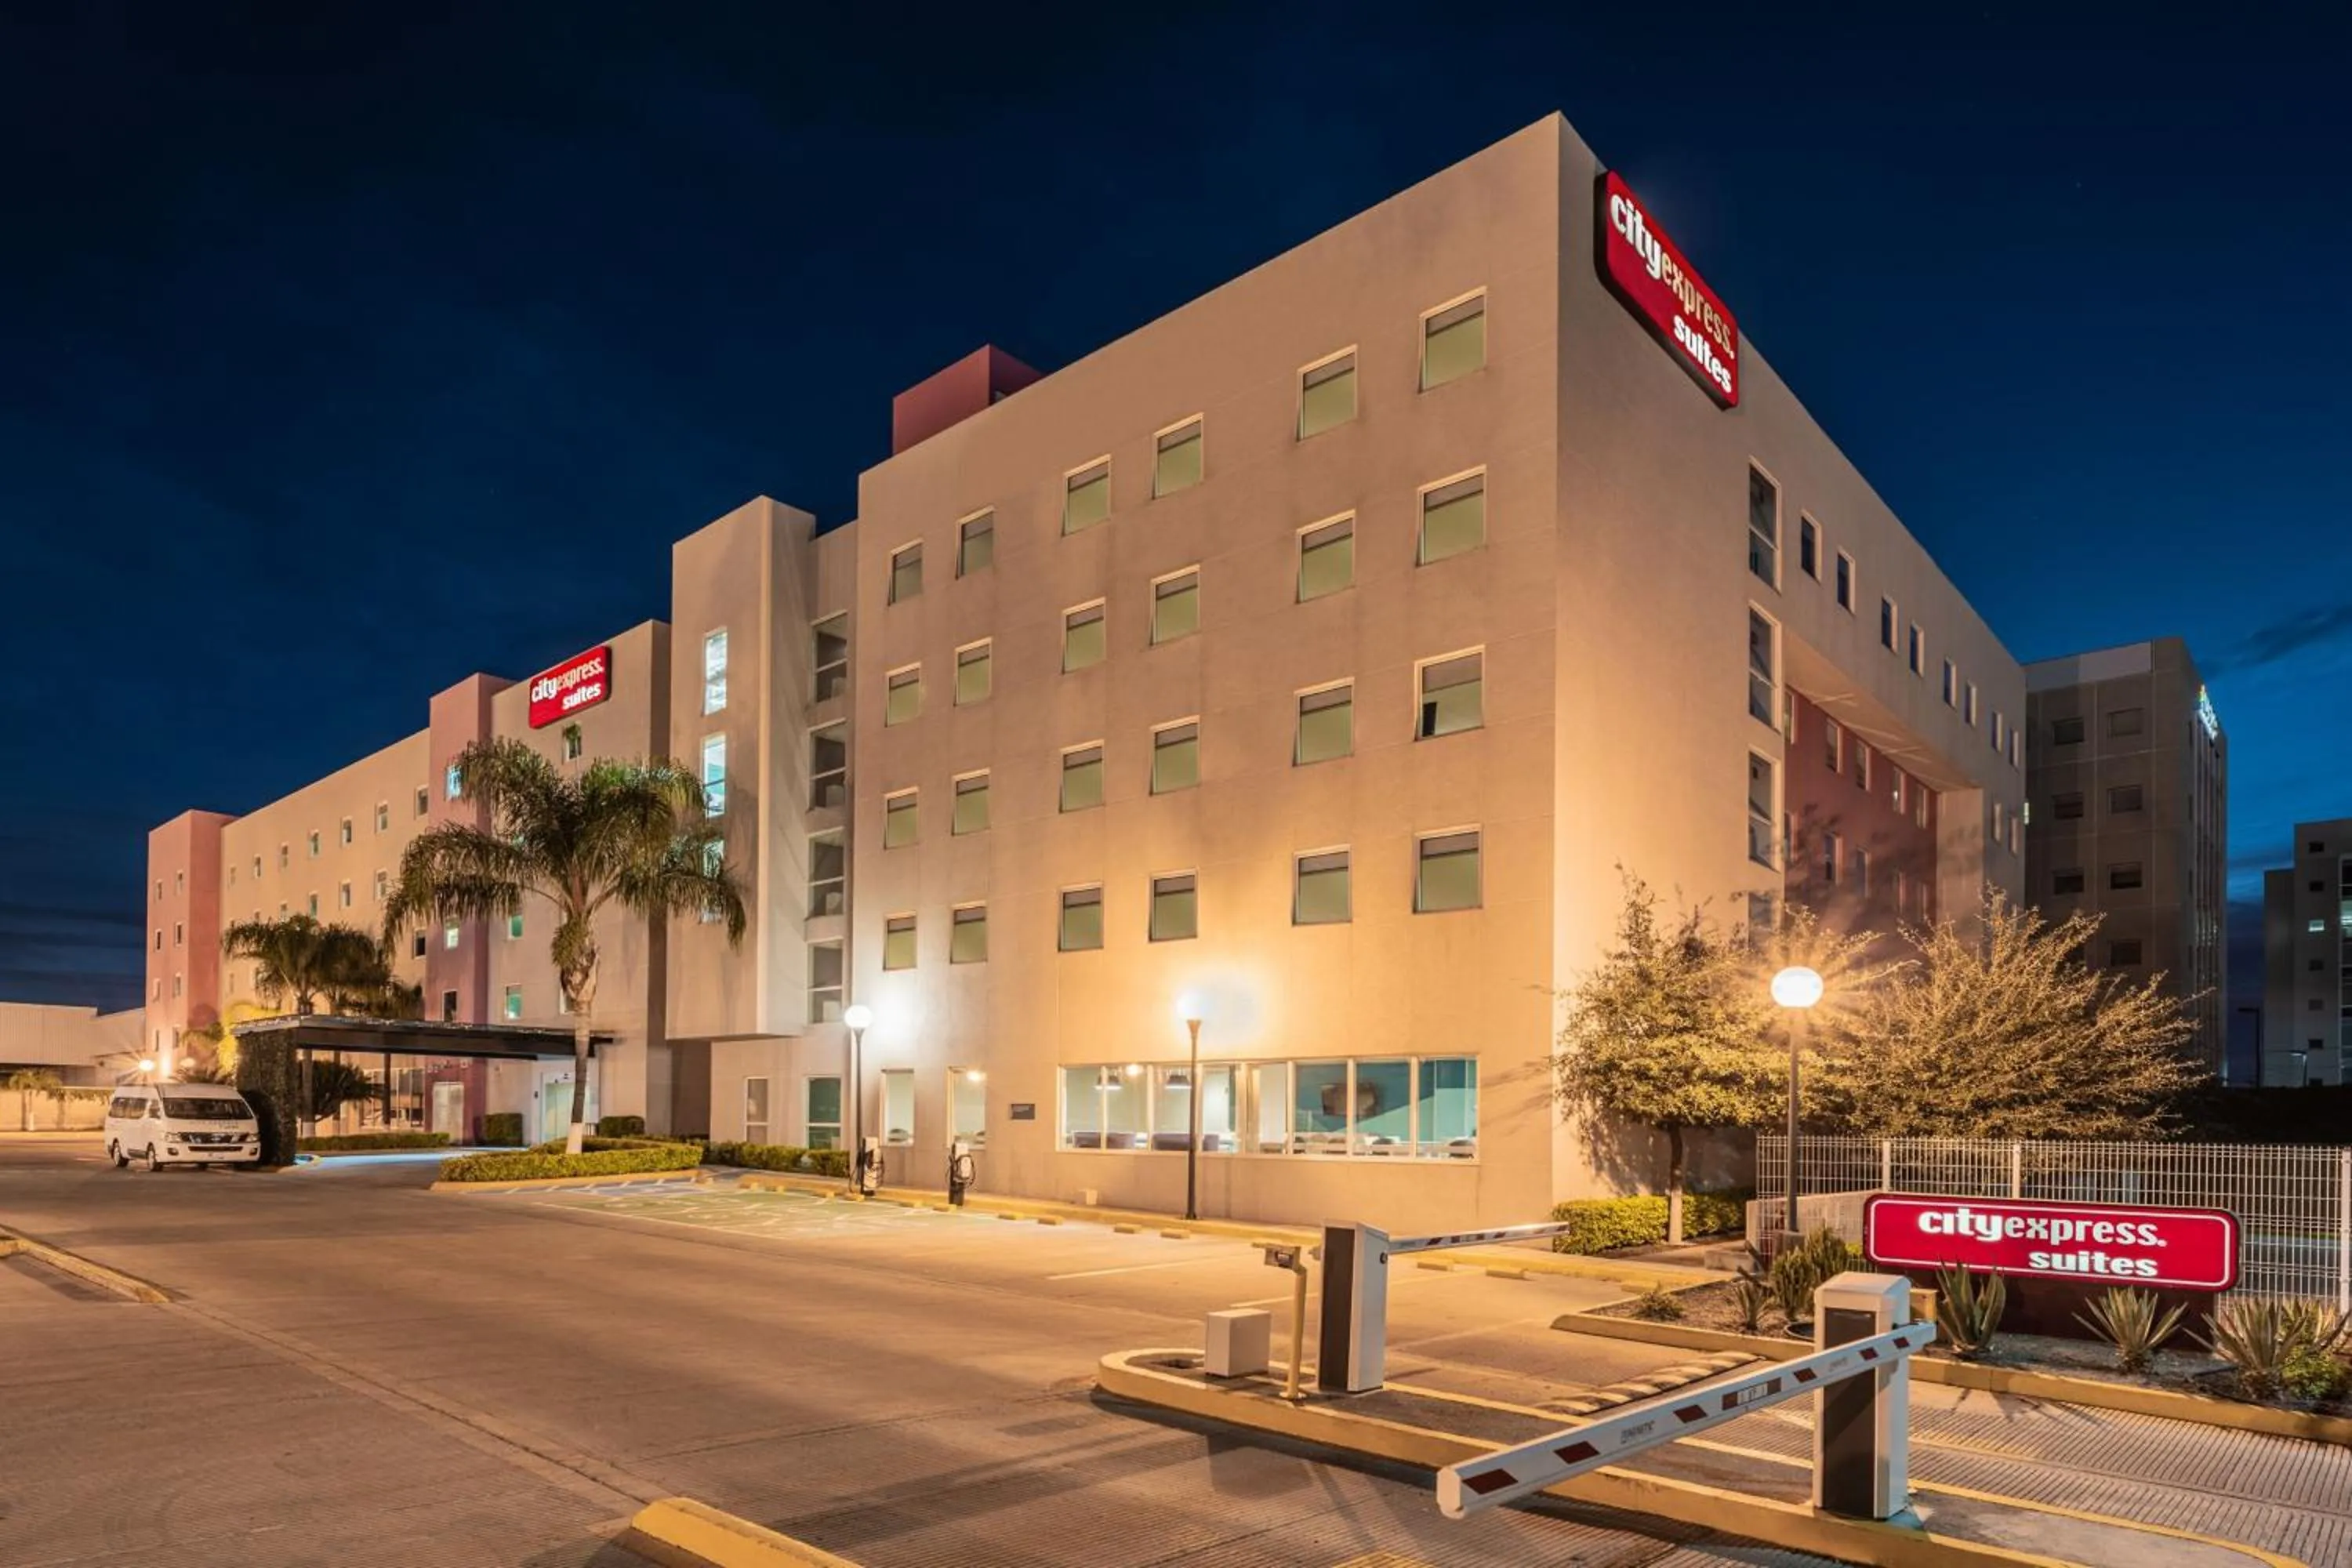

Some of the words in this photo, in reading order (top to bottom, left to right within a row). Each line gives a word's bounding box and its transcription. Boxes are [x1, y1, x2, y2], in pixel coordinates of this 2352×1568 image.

[1673, 314, 1732, 393] suites
[561, 683, 601, 710] suites
[2027, 1250, 2158, 1277] suites
